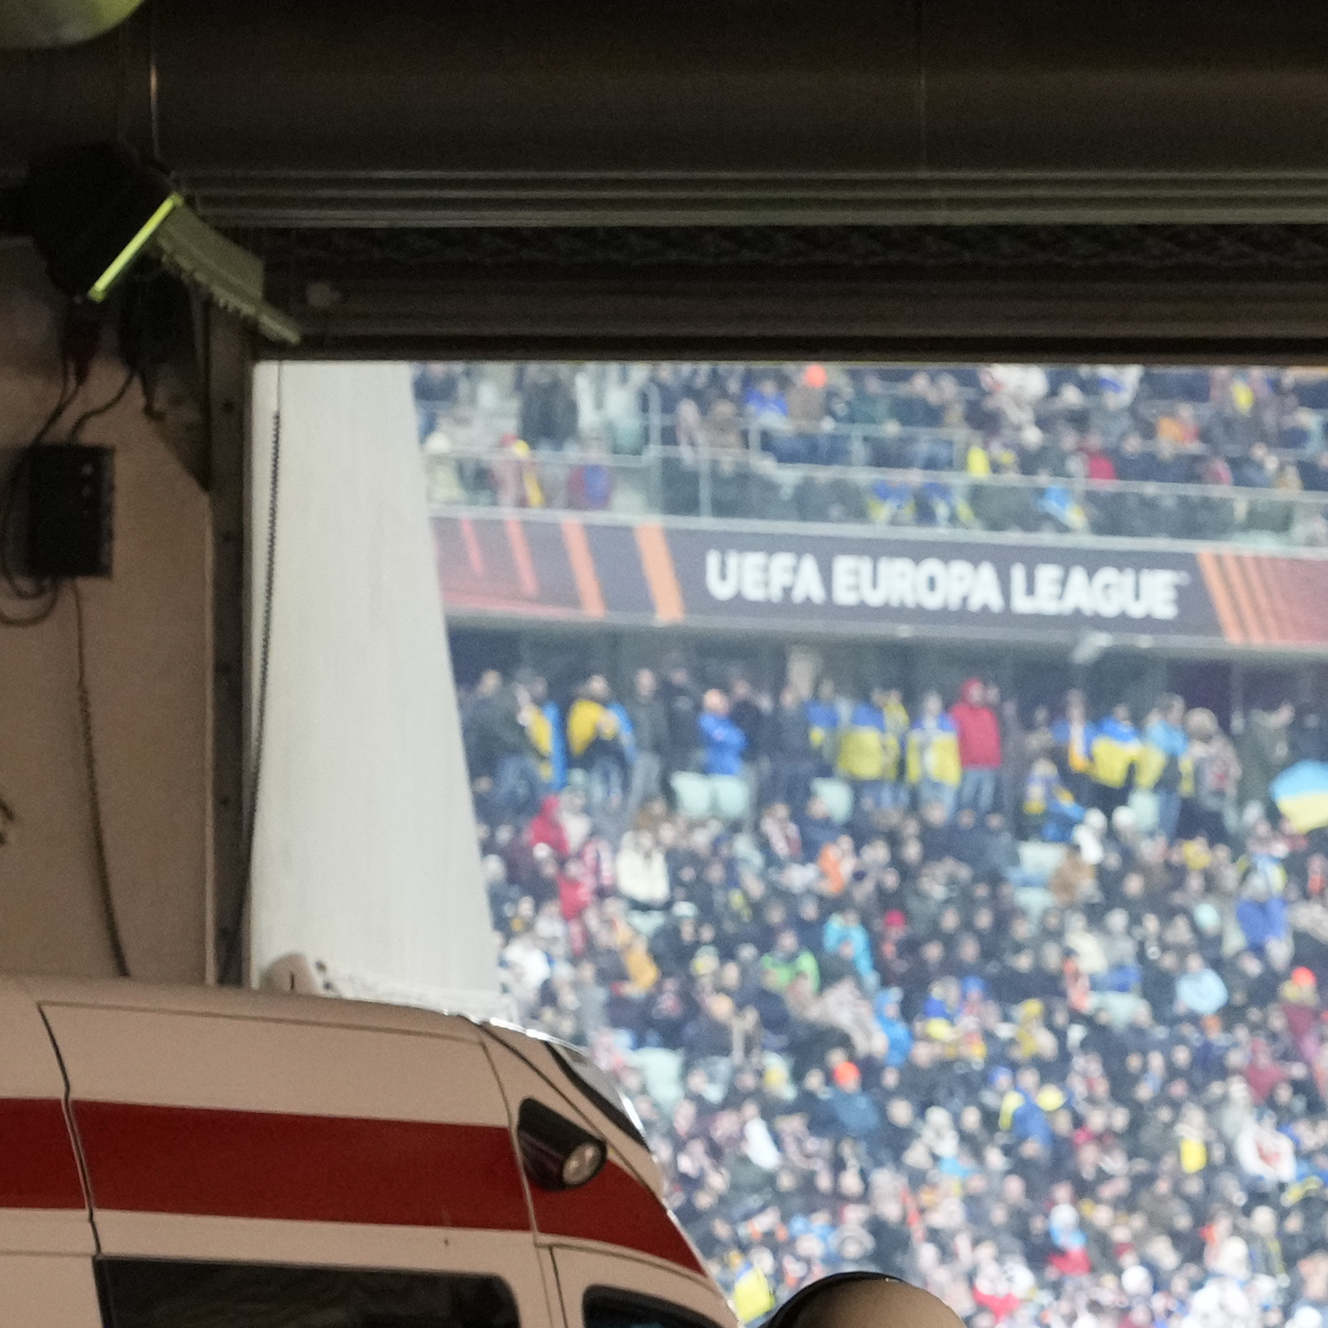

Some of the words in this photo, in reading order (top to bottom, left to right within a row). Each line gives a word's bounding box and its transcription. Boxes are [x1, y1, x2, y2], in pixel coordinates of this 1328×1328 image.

[705, 549, 825, 604] UEFA
[832, 555, 1005, 613] EUROPA
[1010, 562, 1178, 620] LEAGUE
